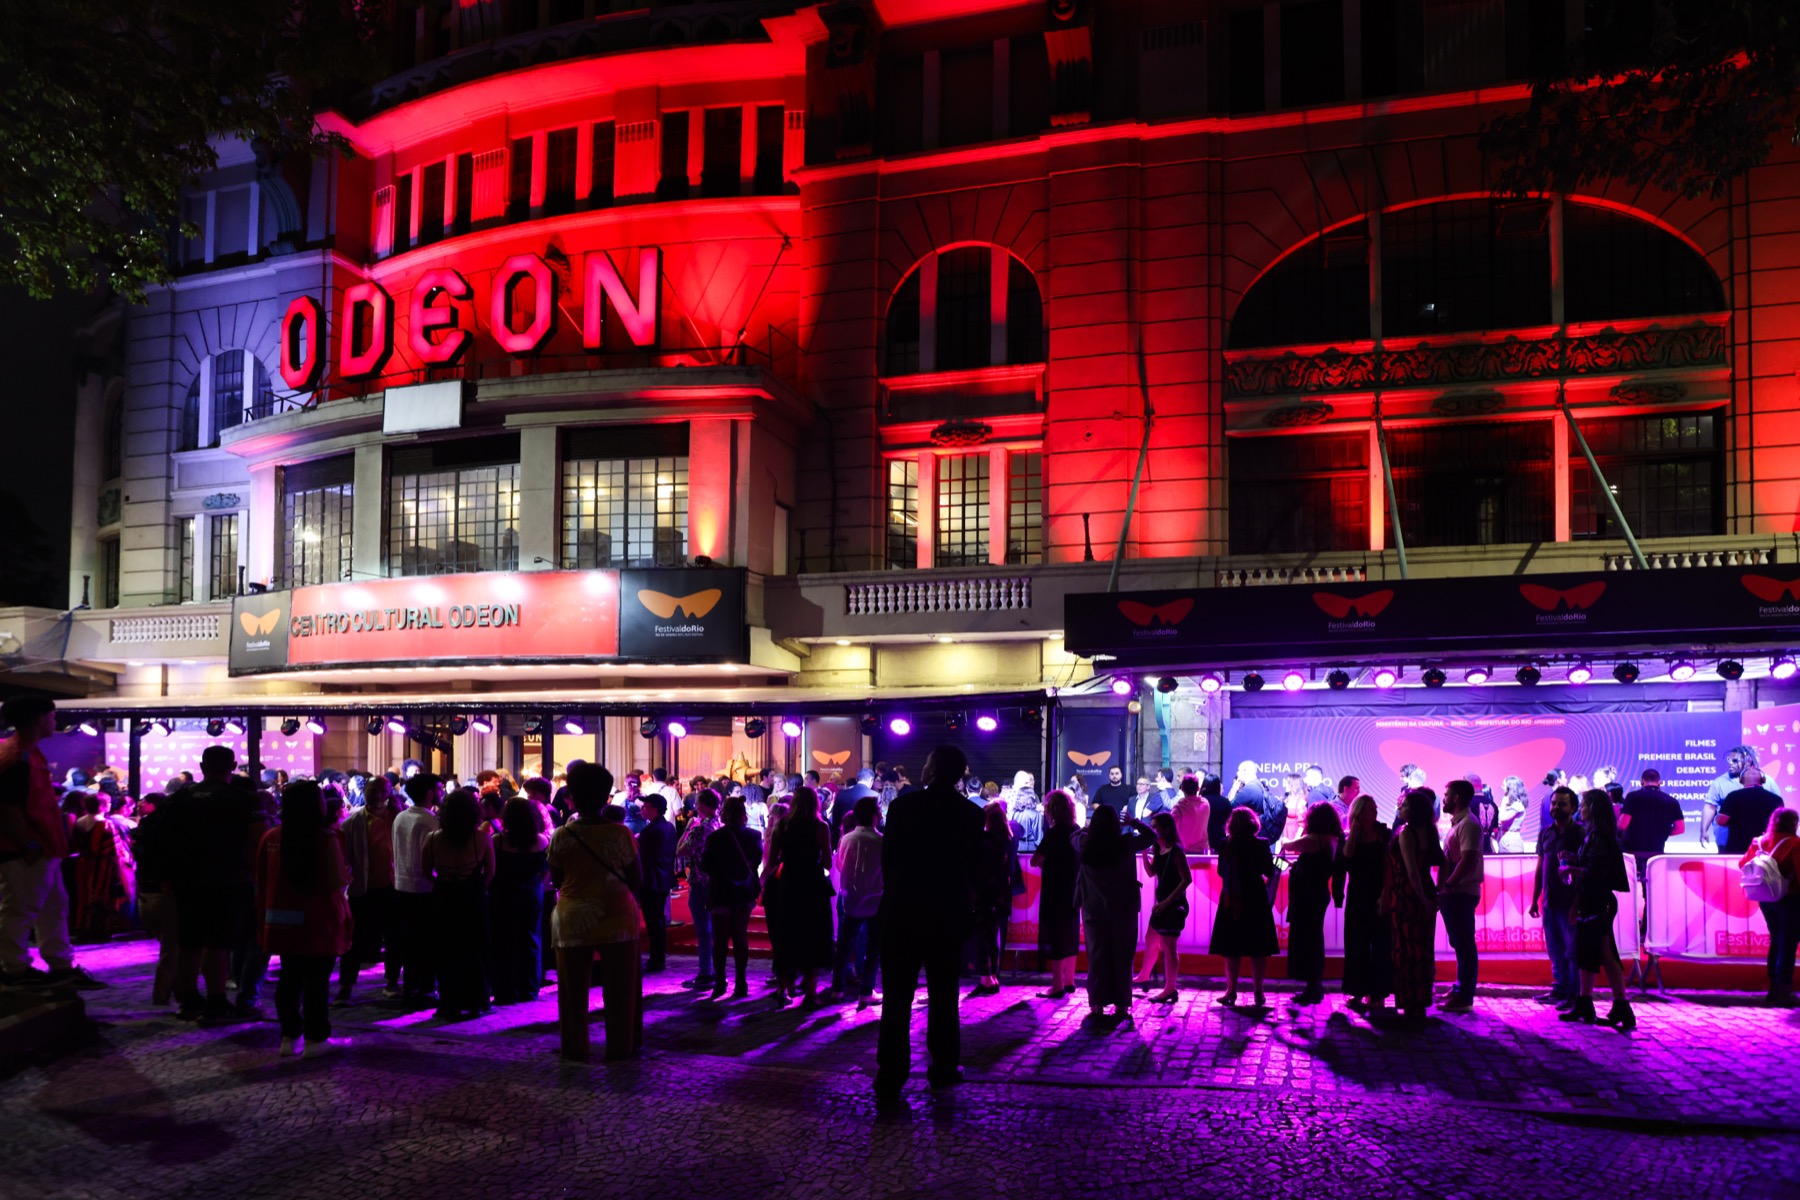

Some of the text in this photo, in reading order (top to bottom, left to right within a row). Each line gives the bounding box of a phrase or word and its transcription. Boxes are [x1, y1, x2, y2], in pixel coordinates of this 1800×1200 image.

[290, 603, 520, 637] CENTRO CULTURAL ODEON
[1685, 739, 1716, 747] FILMES
[1638, 752, 1716, 761] PREMIERE BRASIL
[1256, 762, 1291, 773] NEMA
[1676, 766, 1716, 774] DEBATES
